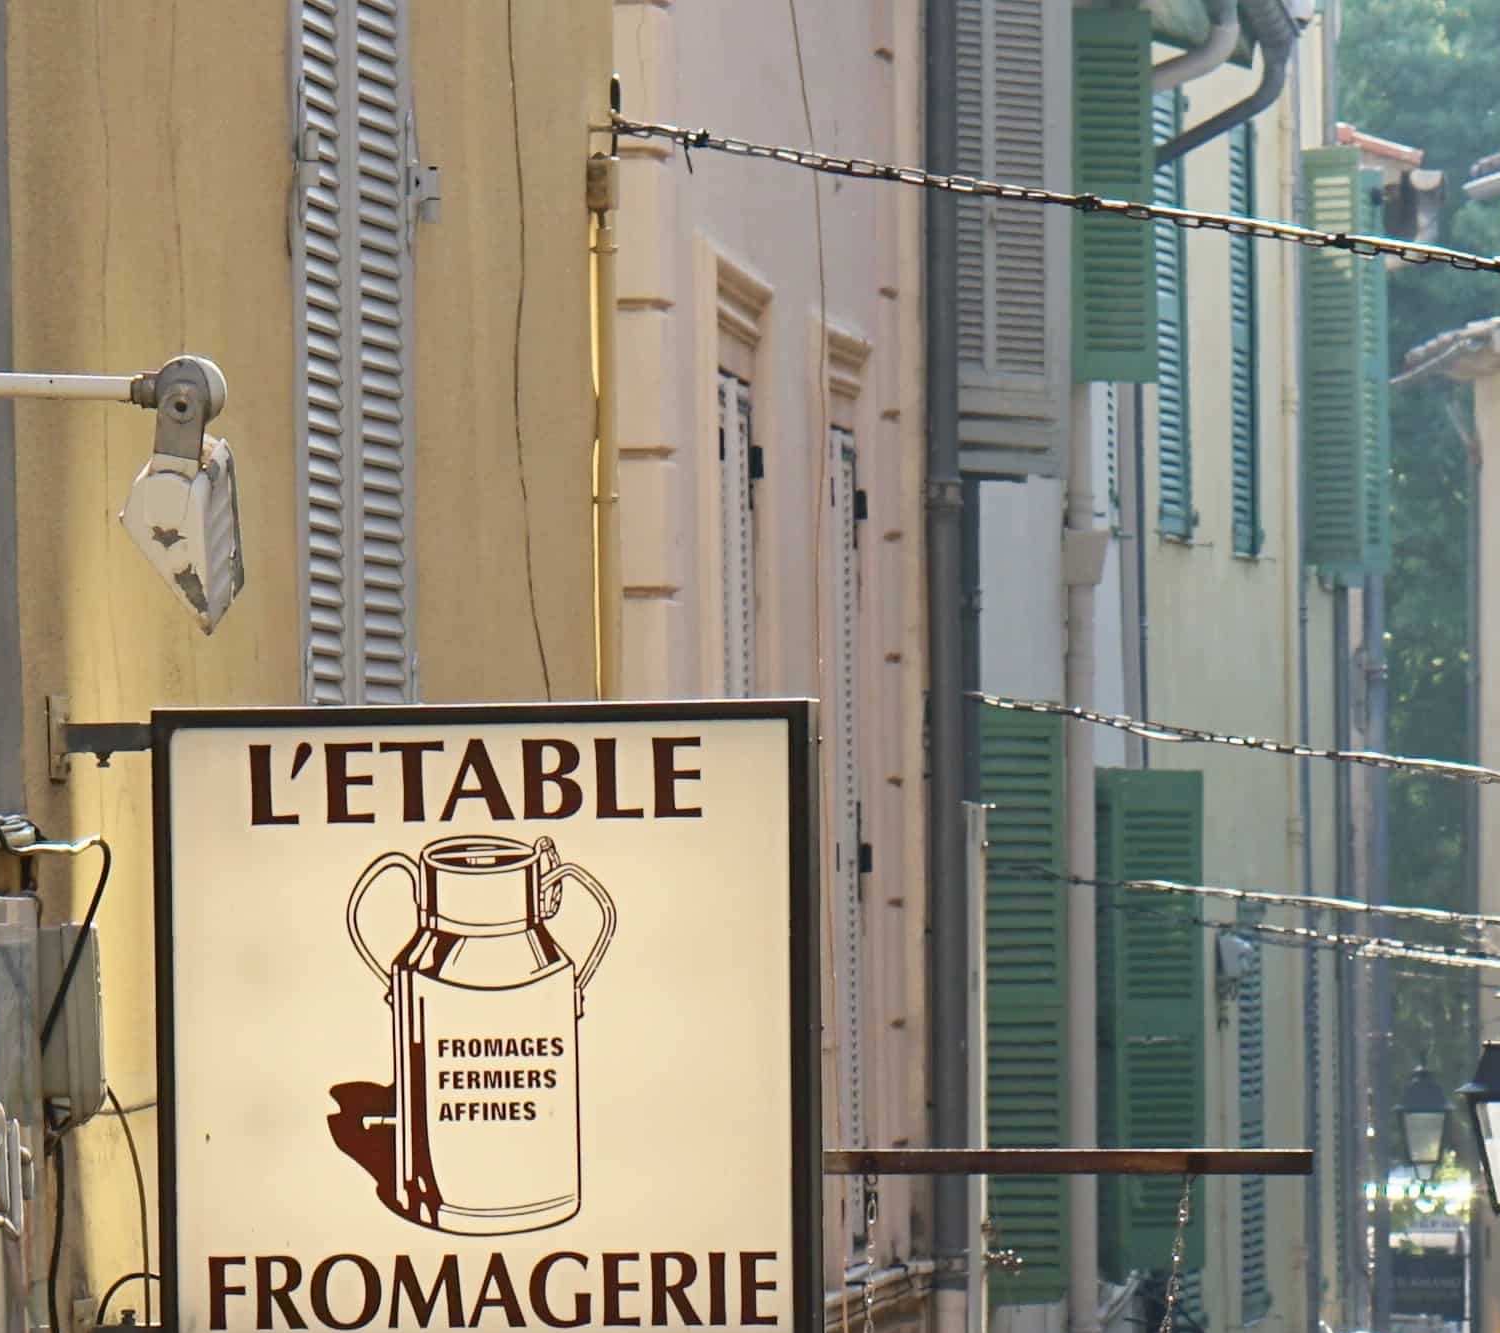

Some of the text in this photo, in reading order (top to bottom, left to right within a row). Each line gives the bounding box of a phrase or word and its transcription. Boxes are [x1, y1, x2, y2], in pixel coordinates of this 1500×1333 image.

[248, 735, 704, 828] L'ETABLE
[437, 1036, 565, 1060] FROMAGES
[438, 1069, 559, 1092] FERMIERS
[438, 1100, 537, 1123] AFFINES
[207, 1249, 781, 1332] FROMAGERIE
